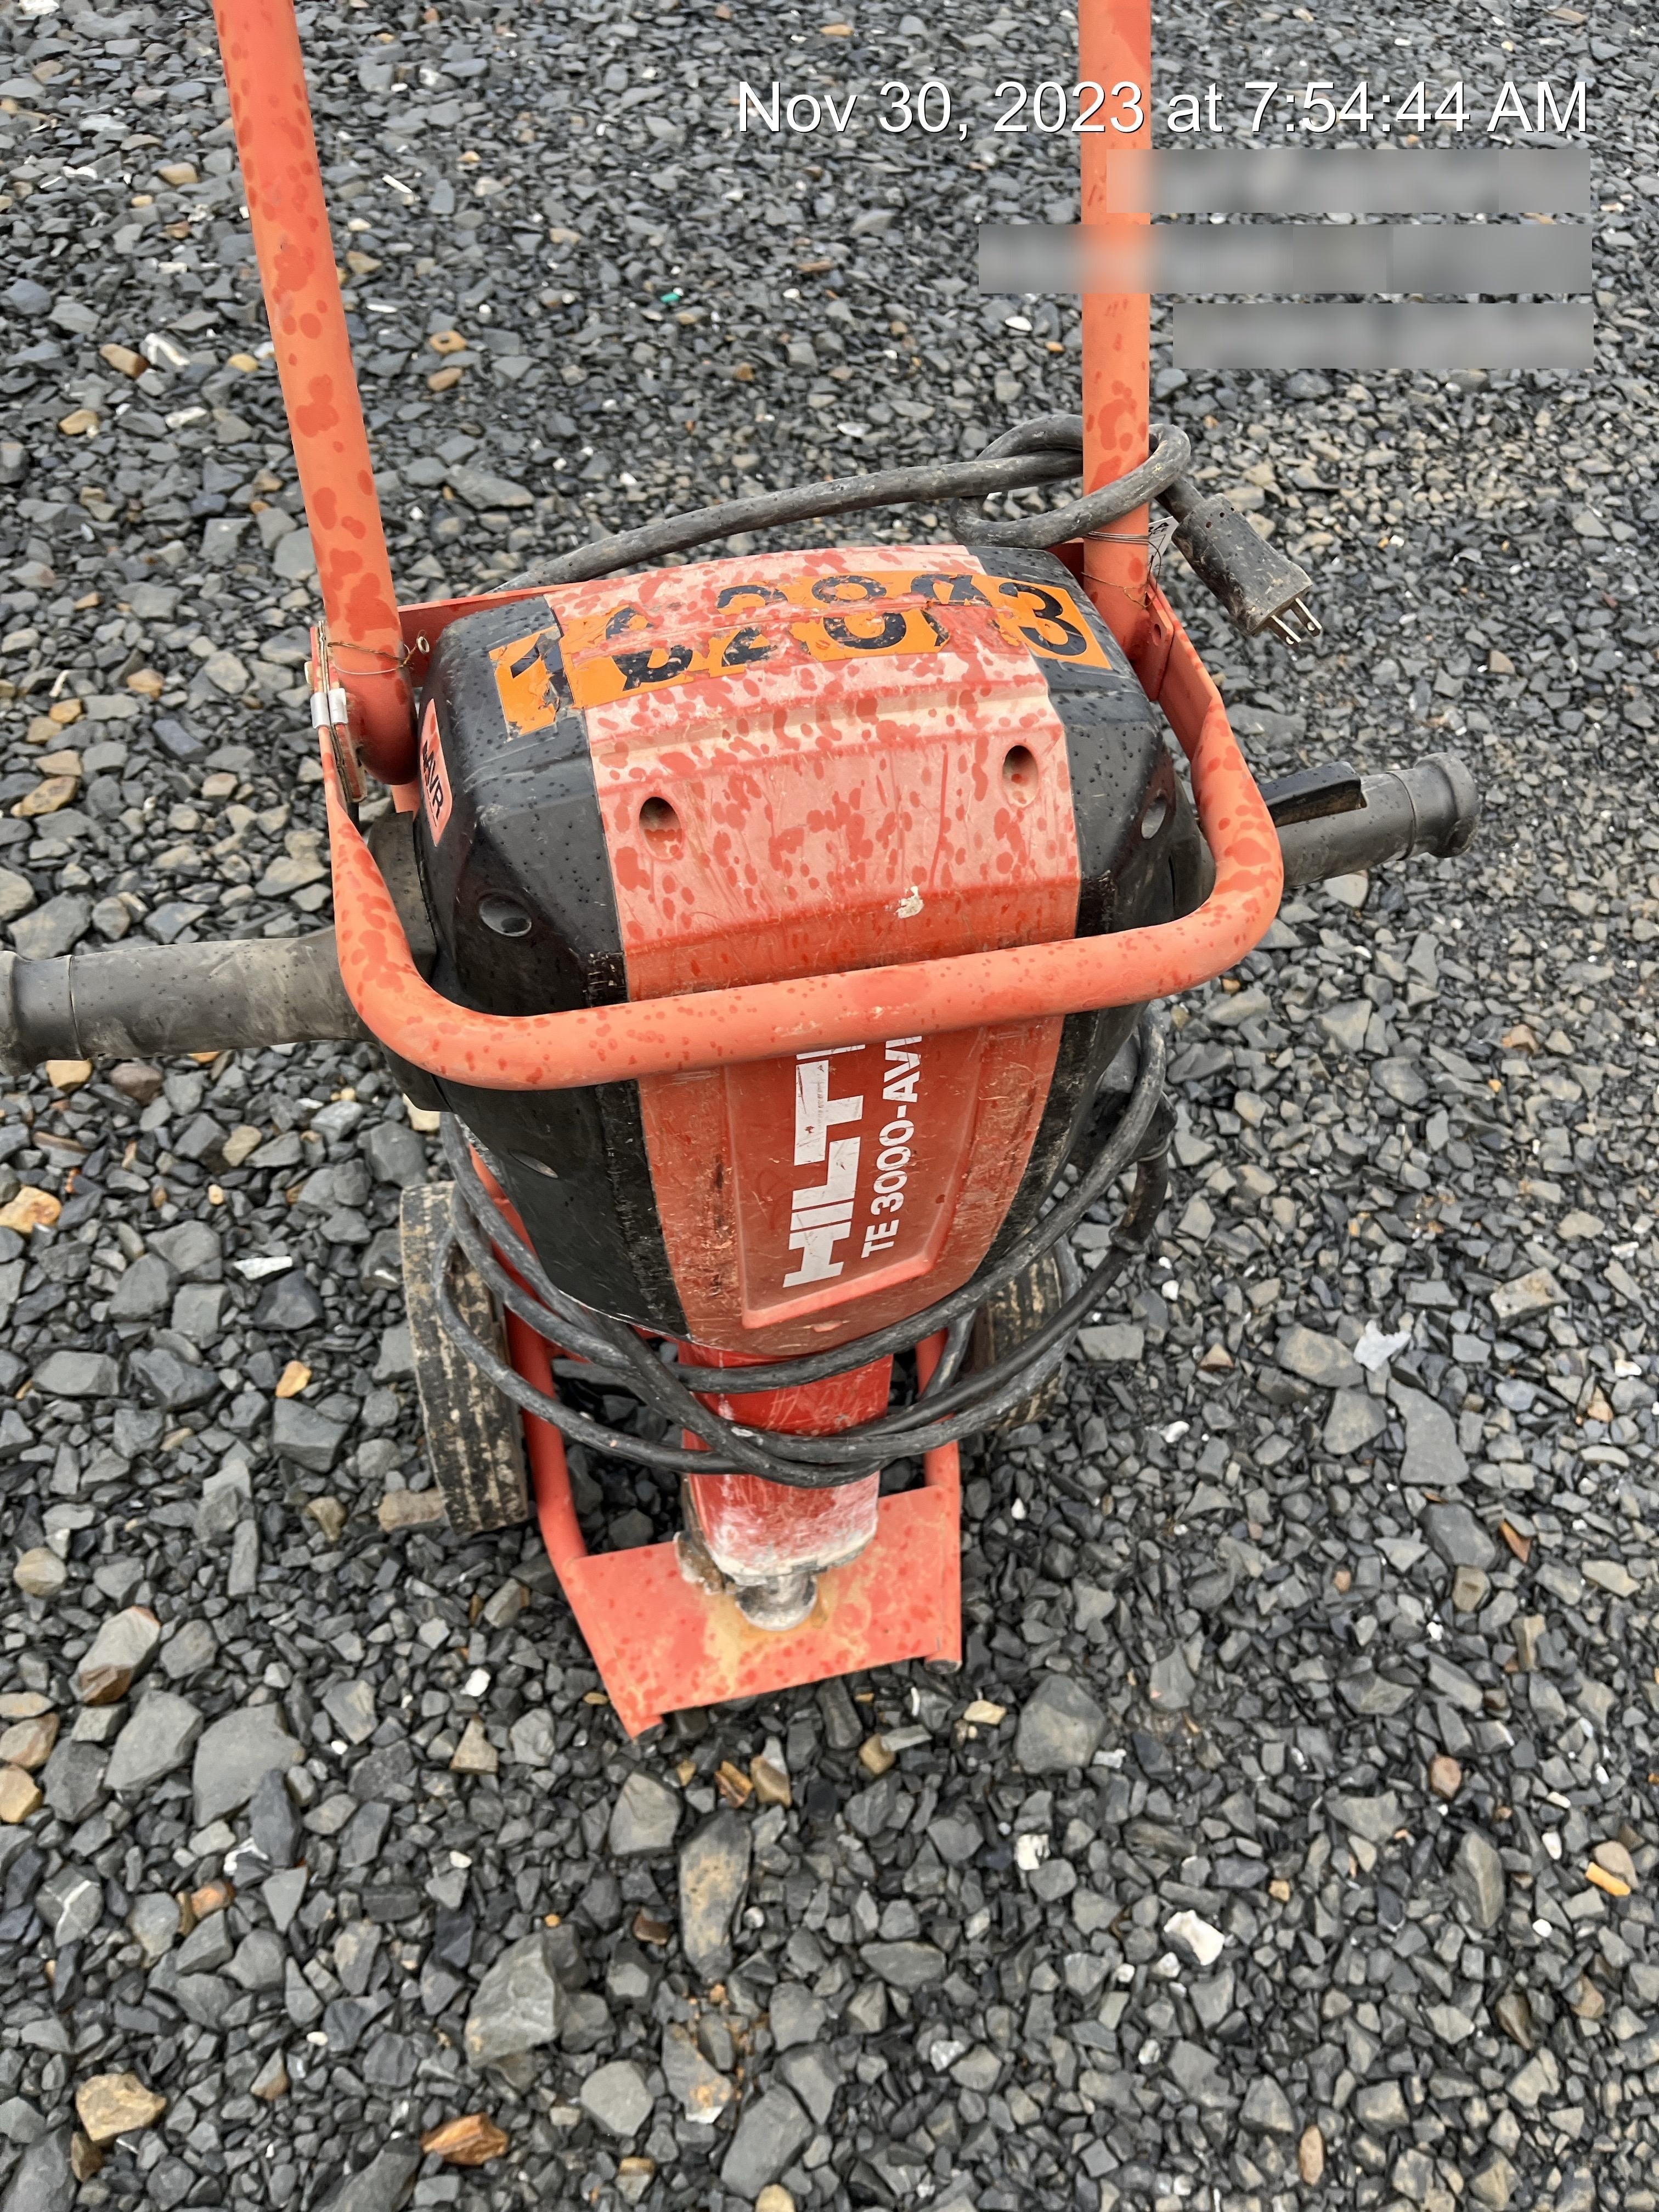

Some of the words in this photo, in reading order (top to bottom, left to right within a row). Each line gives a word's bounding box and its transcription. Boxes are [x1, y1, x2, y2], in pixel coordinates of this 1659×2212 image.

[782, 1043, 866, 1288] HILT
[870, 1035, 923, 1216] 3000-AV
[860, 1218, 900, 1259] TE
